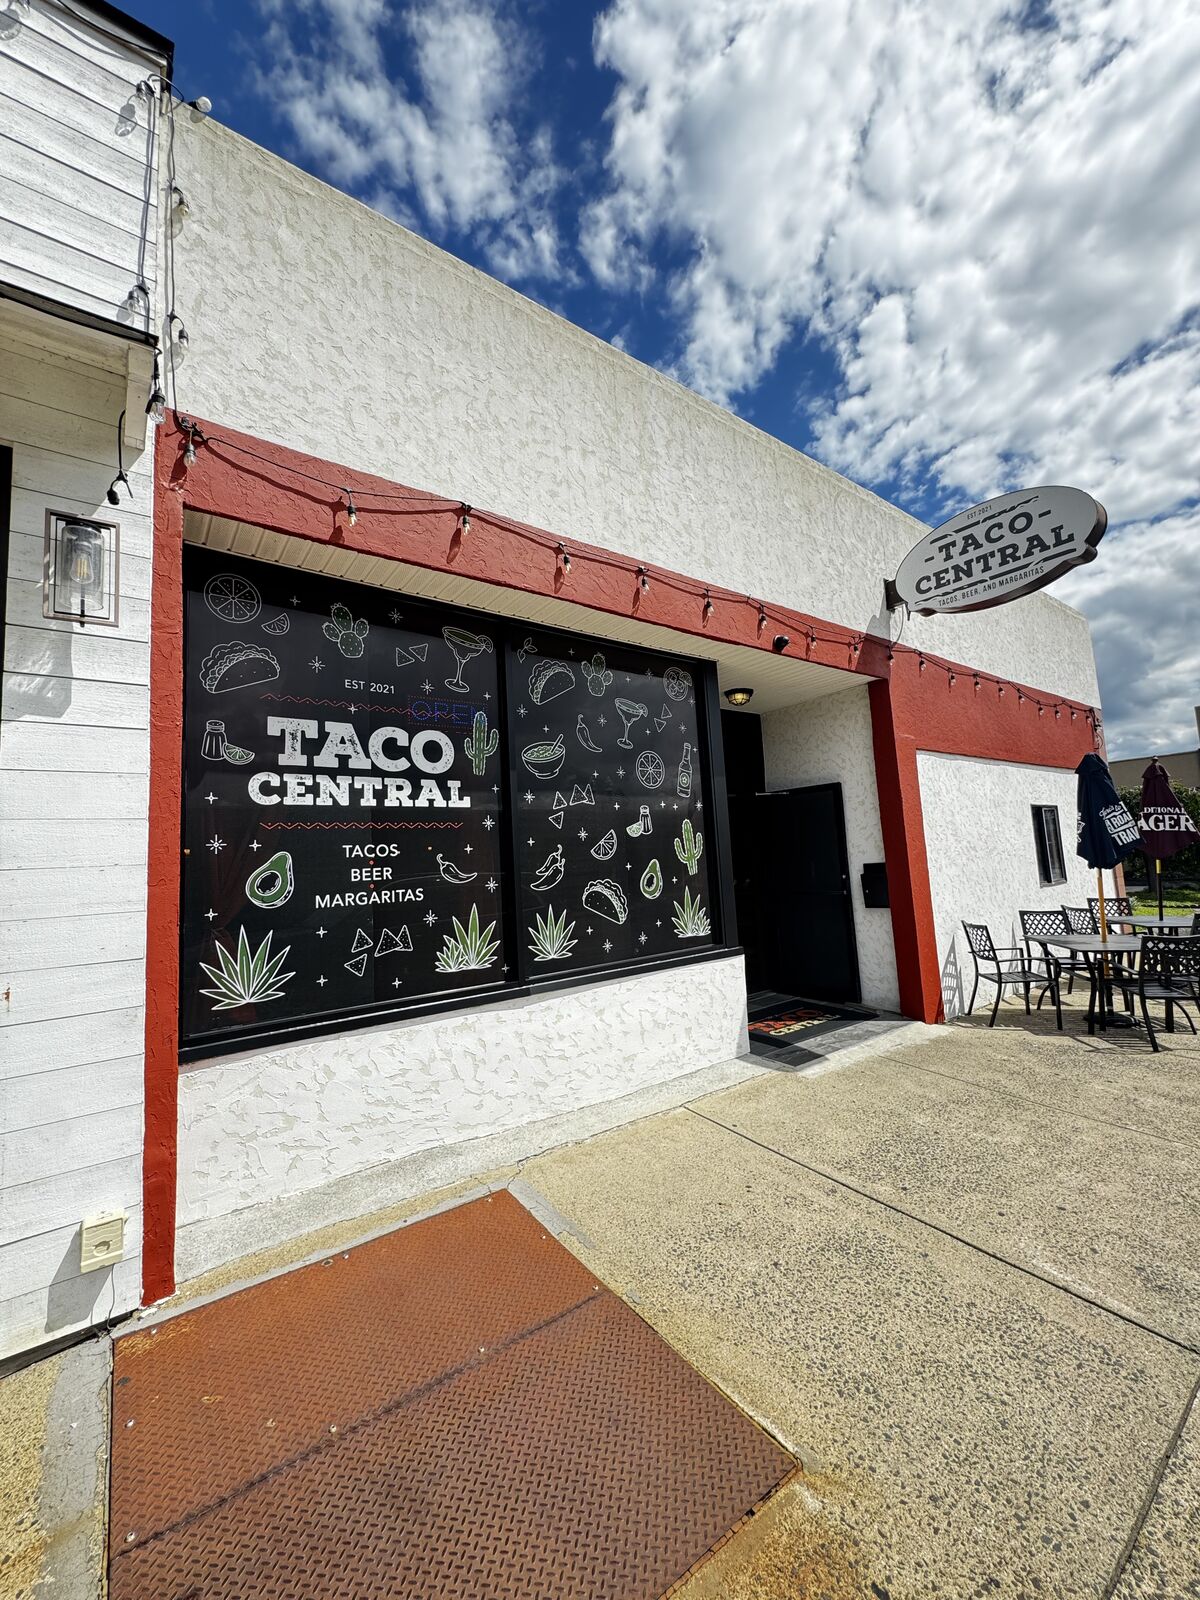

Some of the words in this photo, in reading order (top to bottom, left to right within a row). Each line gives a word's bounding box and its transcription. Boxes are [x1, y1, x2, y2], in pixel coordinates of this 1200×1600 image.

[967, 510, 977, 520] EST
[978, 505, 993, 516] 2021
[938, 511, 1033, 562] TACO
[915, 524, 1075, 594] CENTRAL
[983, 583, 997, 593] AND
[998, 565, 1045, 588] MARGARITAS
[344, 679, 366, 690] EST
[370, 682, 395, 694] 2021
[267, 715, 455, 774] TACO
[247, 771, 471, 808] CENTRAL
[342, 843, 400, 858] TACOS
[350, 867, 393, 881] BEER
[315, 887, 425, 909] MARGARITAS
